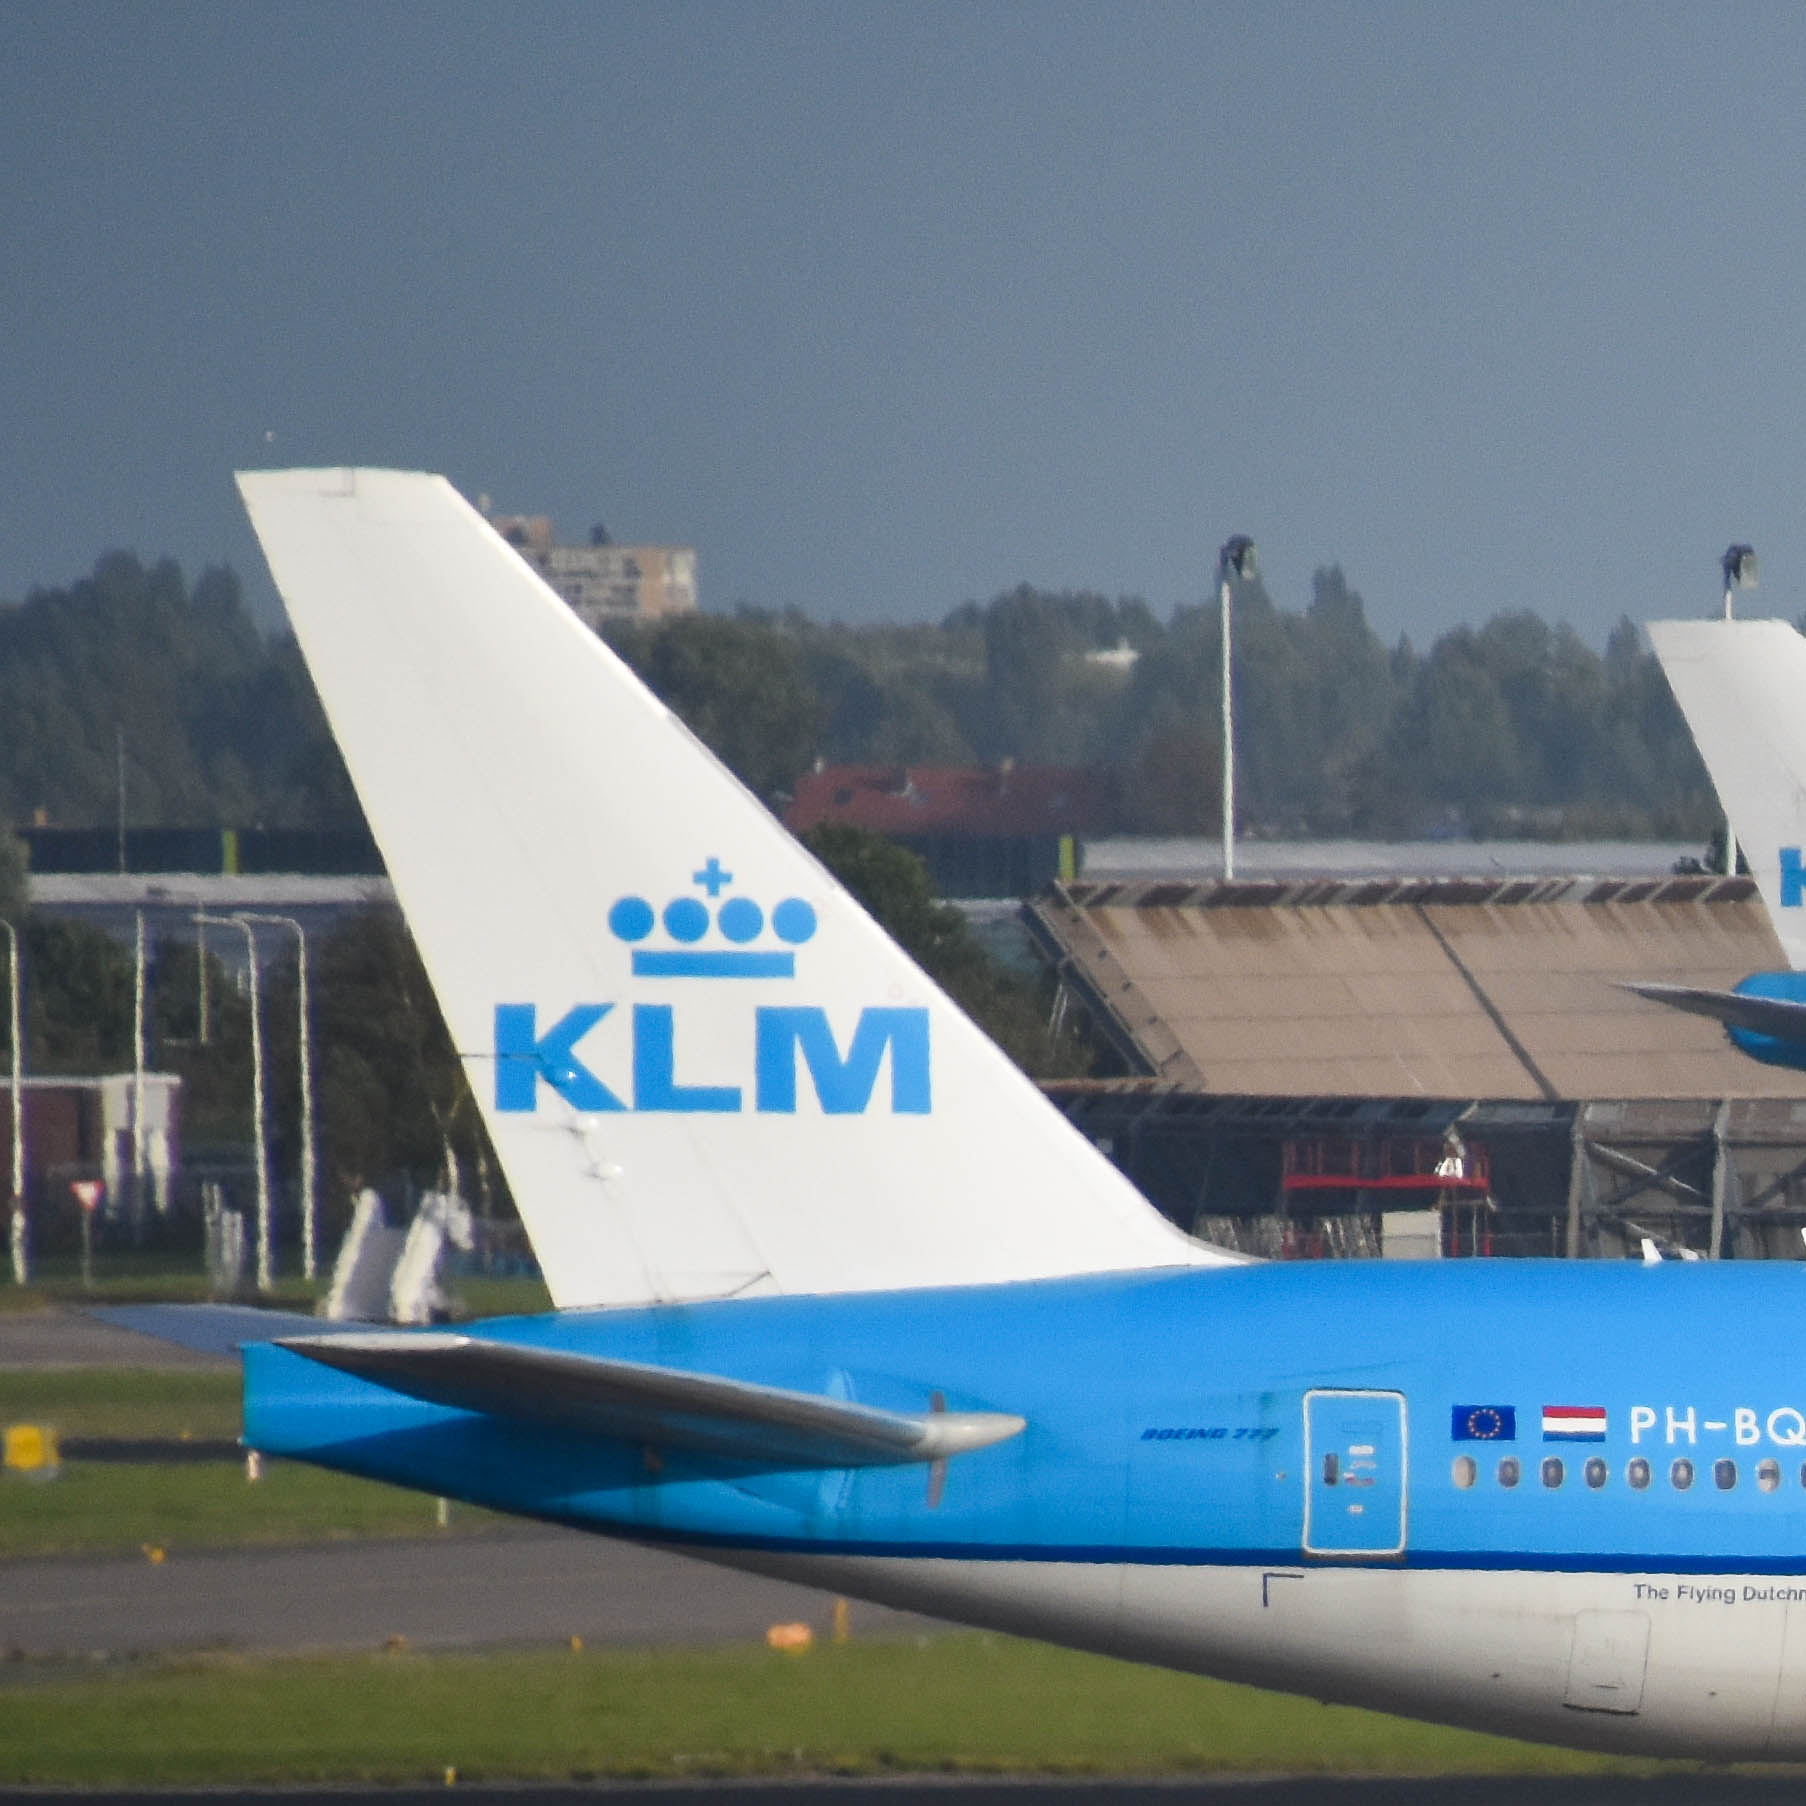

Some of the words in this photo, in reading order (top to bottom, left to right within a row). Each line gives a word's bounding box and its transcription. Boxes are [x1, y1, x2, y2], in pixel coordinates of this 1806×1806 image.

[494, 1003, 931, 1114] KLM
[1140, 1428, 1228, 1440] BOEING
[1233, 1428, 1279, 1440] 777
[1634, 1584, 1669, 1600] The
[1677, 1584, 1735, 1604] Flying
